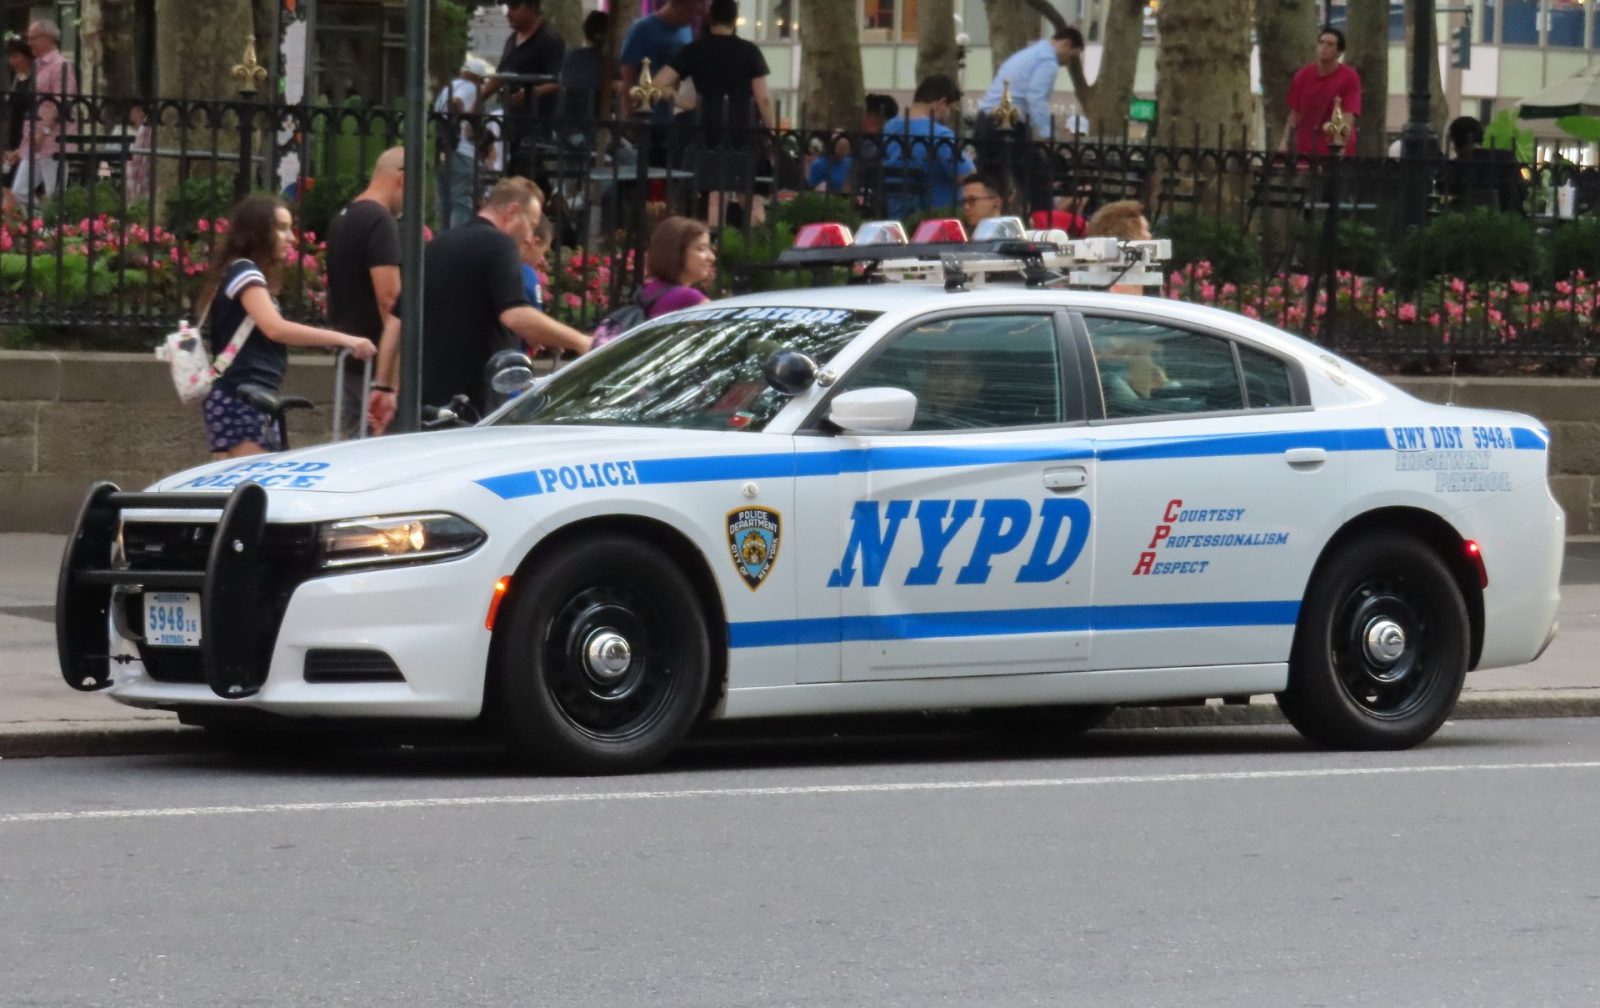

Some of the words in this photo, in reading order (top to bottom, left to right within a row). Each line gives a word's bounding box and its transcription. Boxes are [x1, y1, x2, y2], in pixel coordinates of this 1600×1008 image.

[1393, 426, 1427, 449] HWY
[1429, 426, 1464, 449] DIST
[1395, 451, 1493, 471] HIGHWAY
[539, 460, 637, 493] POLICE
[1435, 471, 1511, 492] PATROL
[738, 510, 768, 521] POLICE
[1163, 499, 1246, 523] COURTESY
[729, 518, 778, 535] DEPARTMENT
[1148, 525, 1290, 549] PROFESSIONALISM
[826, 498, 1091, 587] NYPD
[731, 543, 743, 564] CITY
[740, 565, 749, 577] OF
[758, 562, 770, 579] NEW
[768, 537, 778, 559] YORK
[1132, 551, 1210, 576] RESPECT
